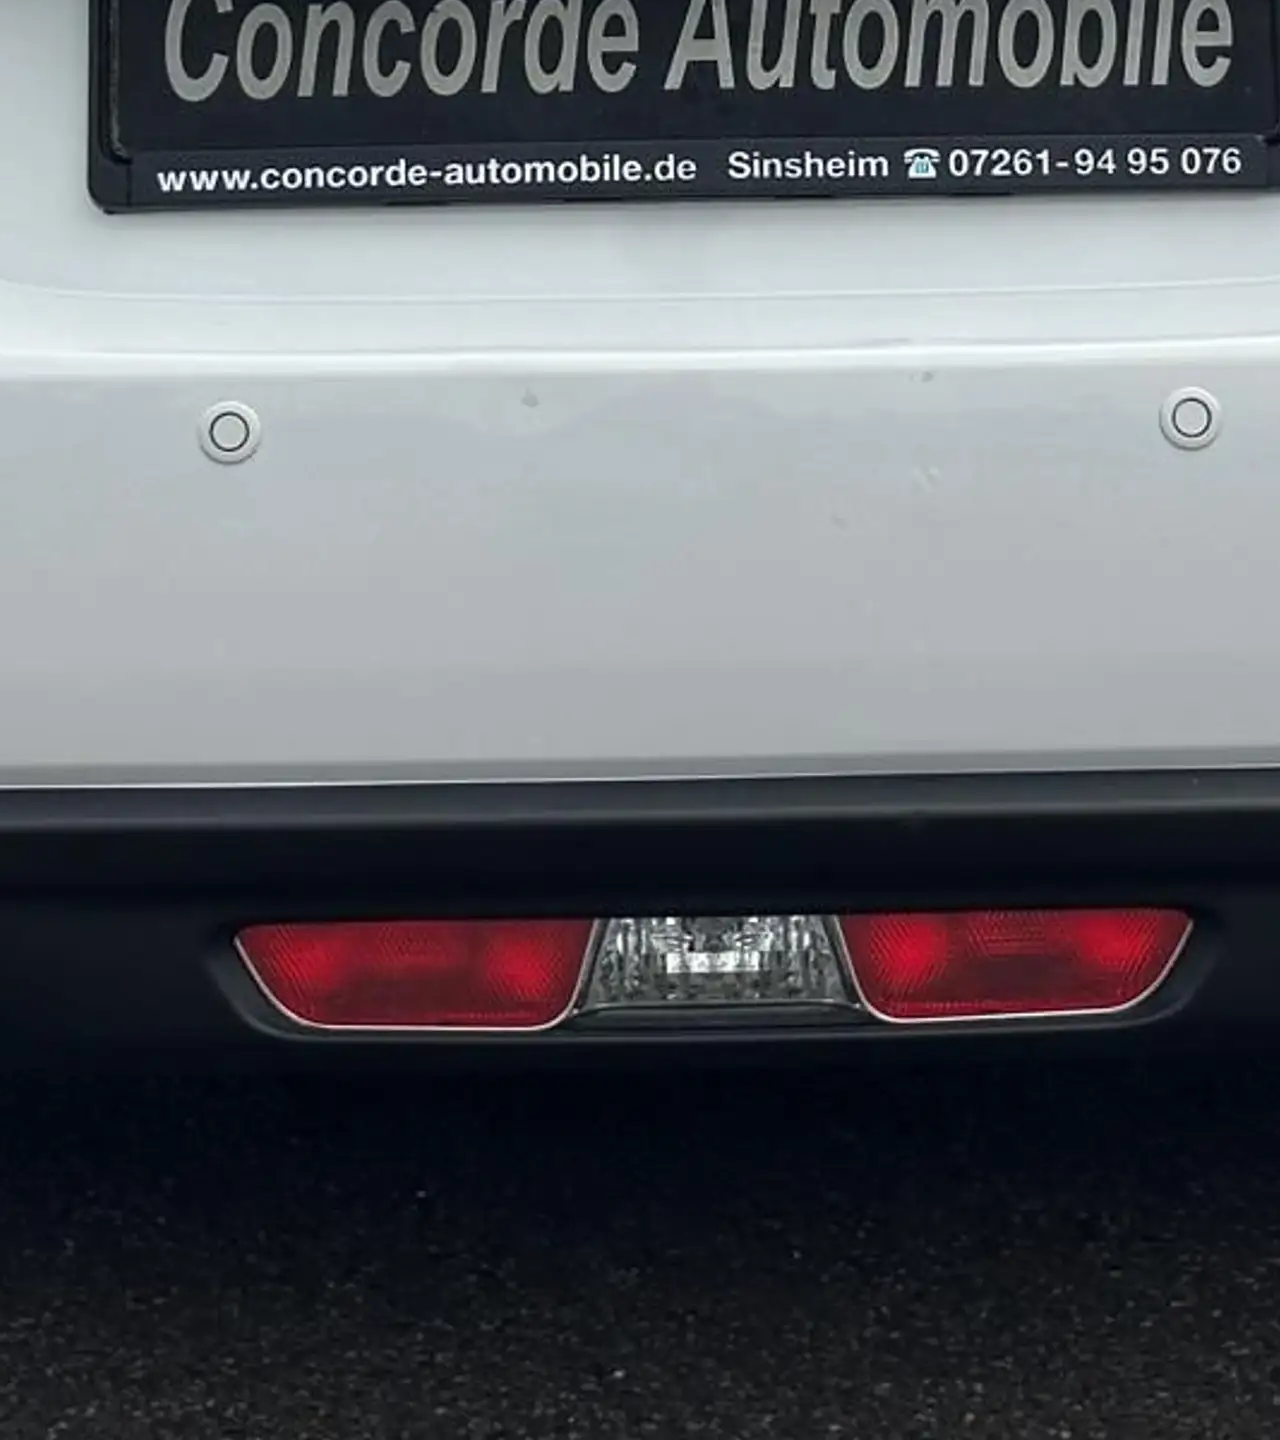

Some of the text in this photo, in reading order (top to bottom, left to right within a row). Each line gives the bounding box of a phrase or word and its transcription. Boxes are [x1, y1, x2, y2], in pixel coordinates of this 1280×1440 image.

[157, 153, 697, 192] www.concorde-automobile.de
[727, 150, 890, 179] Sinsheim
[1127, 147, 1171, 176] 95
[1181, 146, 1243, 175] 076
